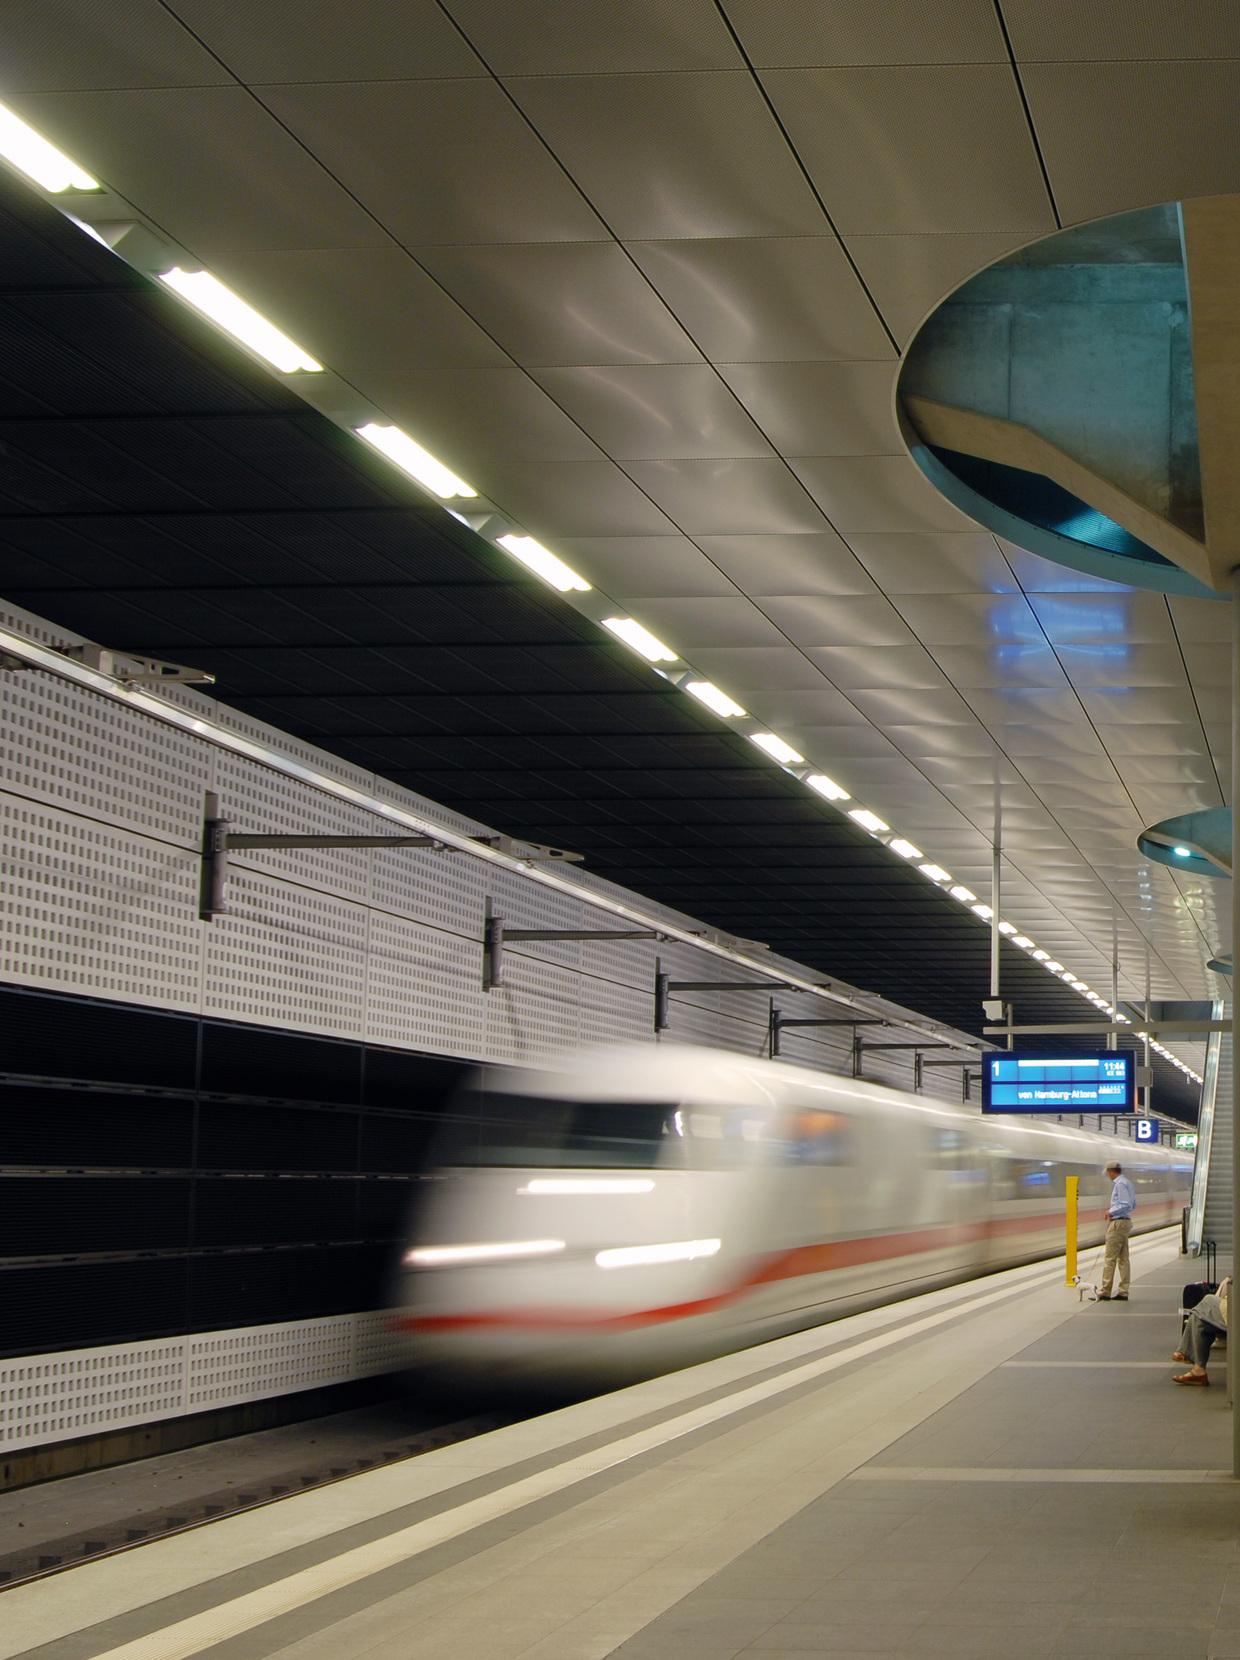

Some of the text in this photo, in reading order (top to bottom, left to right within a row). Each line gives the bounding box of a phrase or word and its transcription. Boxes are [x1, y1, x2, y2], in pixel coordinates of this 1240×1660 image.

[992, 1061, 1000, 1077] 1
[1018, 1091, 1097, 1100] von Hamburg-Altona
[1138, 1120, 1152, 1138] B
